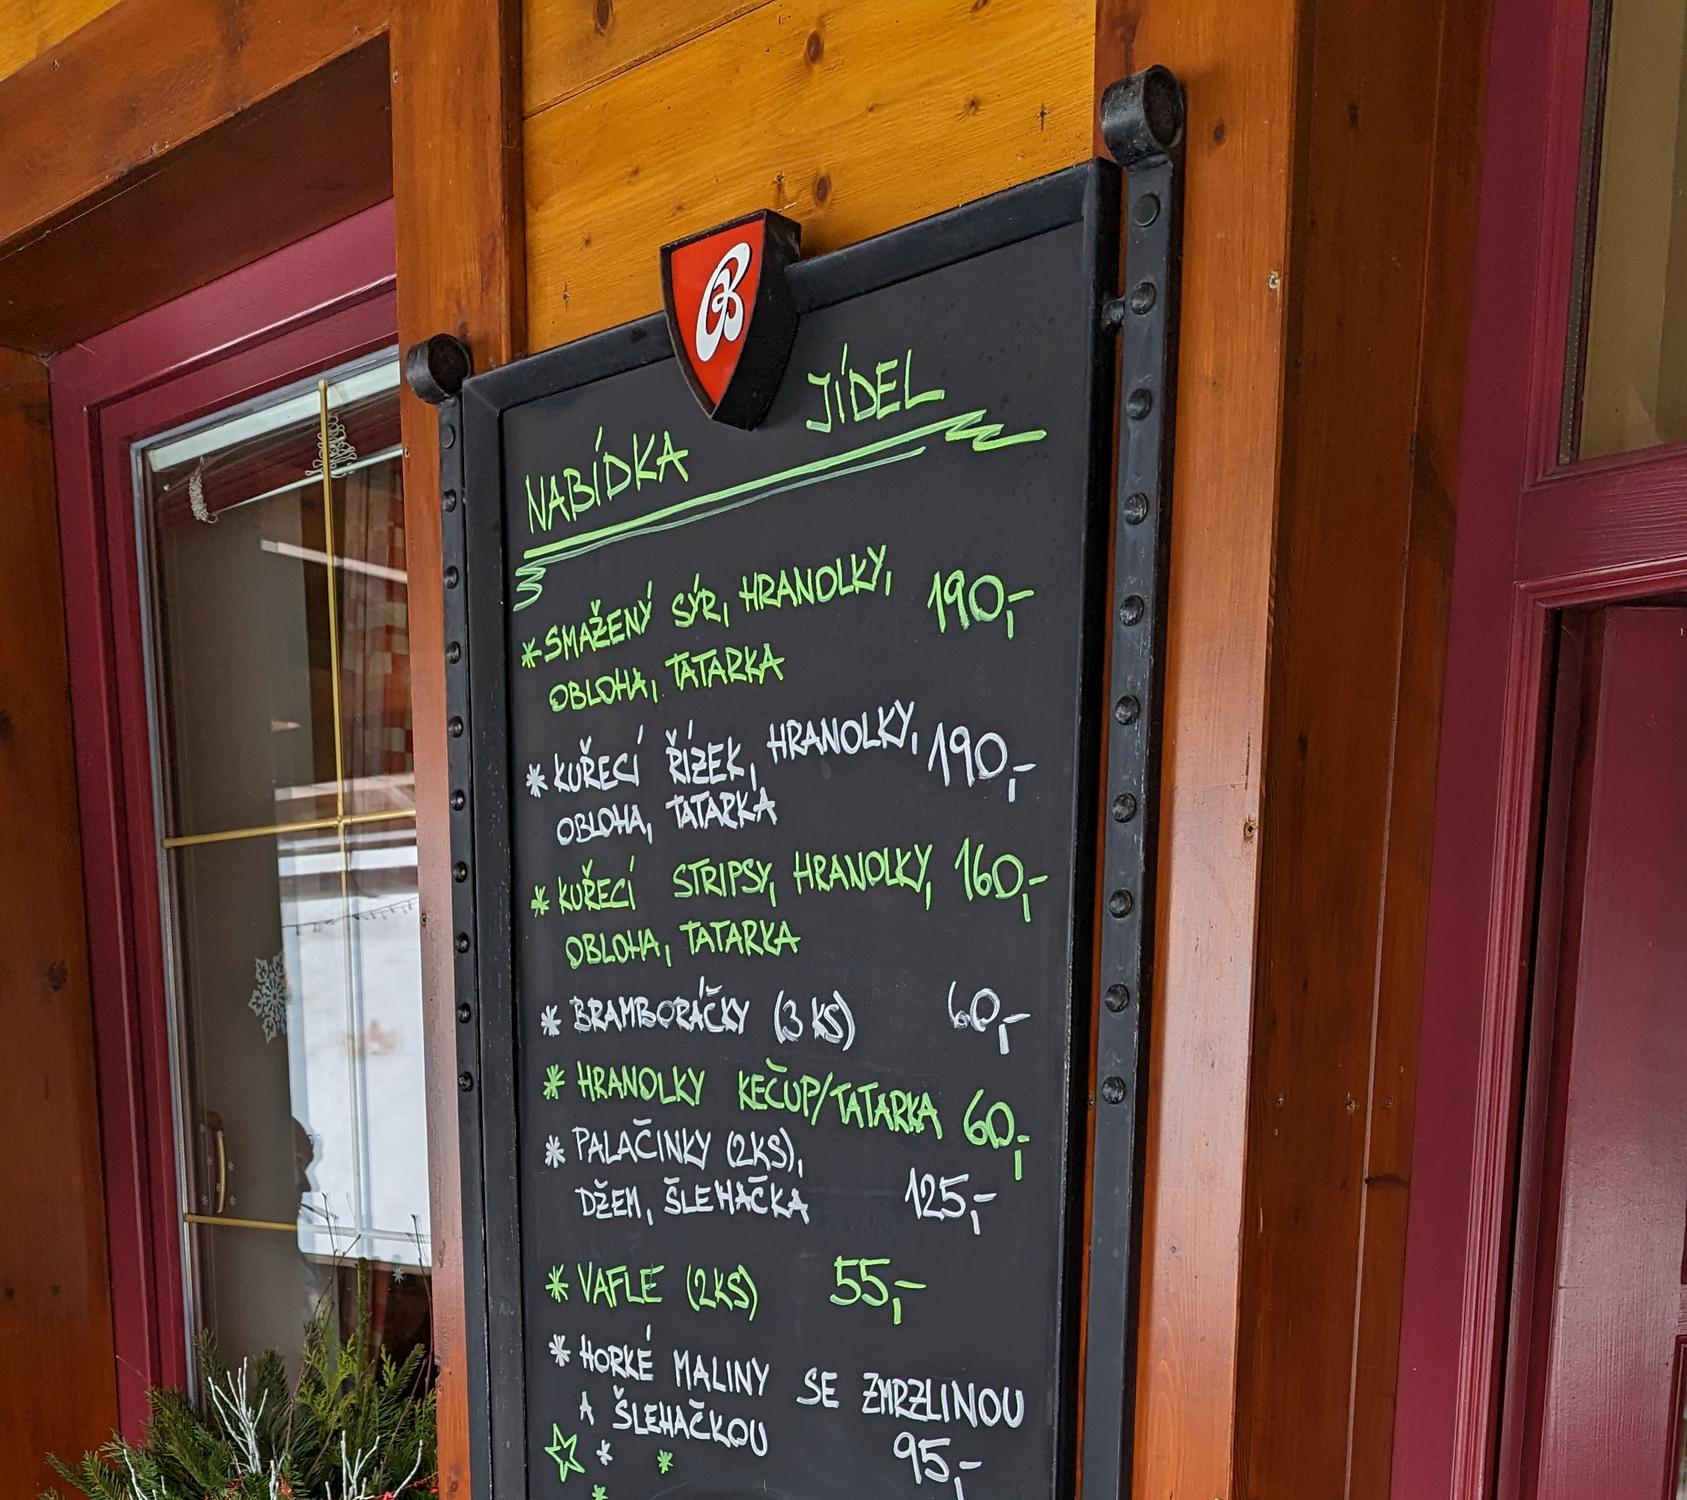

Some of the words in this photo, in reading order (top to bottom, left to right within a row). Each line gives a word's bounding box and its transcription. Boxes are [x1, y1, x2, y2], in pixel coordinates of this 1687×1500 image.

[525, 426, 689, 533] NABÍDKA
[806, 343, 945, 433] JÍDEL
[544, 580, 652, 663] SMAŽENÝ
[672, 572, 729, 628] SÝR,
[738, 544, 892, 613] HRANOLKY,
[926, 570, 1034, 639] 190,-
[549, 667, 658, 712] OBLOHA,
[664, 643, 785, 690] TATARKA
[553, 724, 643, 792] KUŘECÍ
[665, 719, 757, 792] ŘÍZEK,
[766, 700, 918, 764] HRANOLKY,
[927, 722, 1036, 802] 190,-
[556, 803, 652, 845] OBLOHA,
[665, 786, 778, 829] TATARKA
[557, 855, 637, 914] KUŘECÍ
[672, 857, 777, 908] STRIPSY,
[793, 844, 933, 910] HRANOLKY,
[953, 838, 1048, 923] 160,-
[565, 927, 672, 969] OBLOHA,
[680, 920, 800, 957] TATARKA
[570, 976, 749, 1035] BRAMBORÁČKY
[774, 990, 803, 1044] (3
[811, 990, 856, 1051] KS)
[947, 981, 1031, 1055] 60,-
[572, 1118, 711, 1170] PALAČINKY
[577, 1060, 705, 1106] HRANOLKY
[962, 1088, 1030, 1180] 60,-
[575, 1178, 654, 1226] DŽEM,
[663, 1175, 809, 1225] ŠLEHAČKA
[904, 1168, 997, 1236] 125,-
[577, 1261, 664, 1308] VAFLE
[686, 1264, 757, 1321] (2KS)
[829, 1256, 927, 1324] 55,-
[579, 1323, 654, 1381] HORKÉ
[673, 1349, 770, 1396] MALINY
[796, 1367, 840, 1409] SE
[861, 1372, 1026, 1429] ZMRZLINOU
[579, 1391, 595, 1426] A
[612, 1384, 768, 1457] ŠLEHAČKOU
